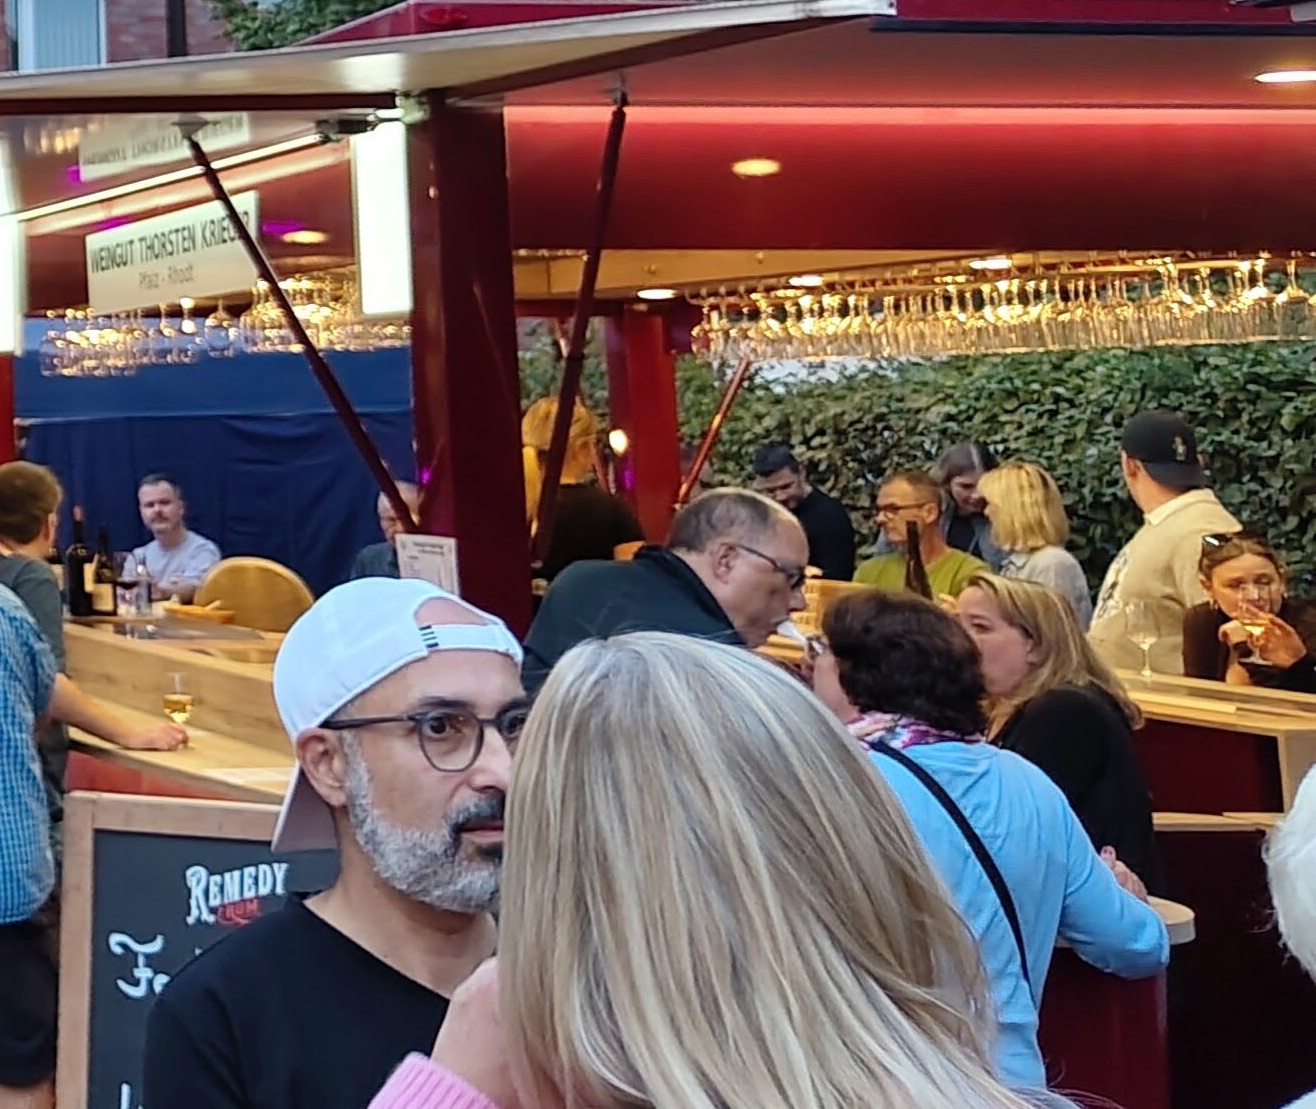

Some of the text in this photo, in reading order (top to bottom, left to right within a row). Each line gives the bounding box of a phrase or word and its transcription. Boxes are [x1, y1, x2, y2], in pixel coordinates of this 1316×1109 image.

[90, 238, 135, 274] WEINGUT
[138, 223, 198, 263] THORSTEN
[185, 862, 289, 926] REMEDY
